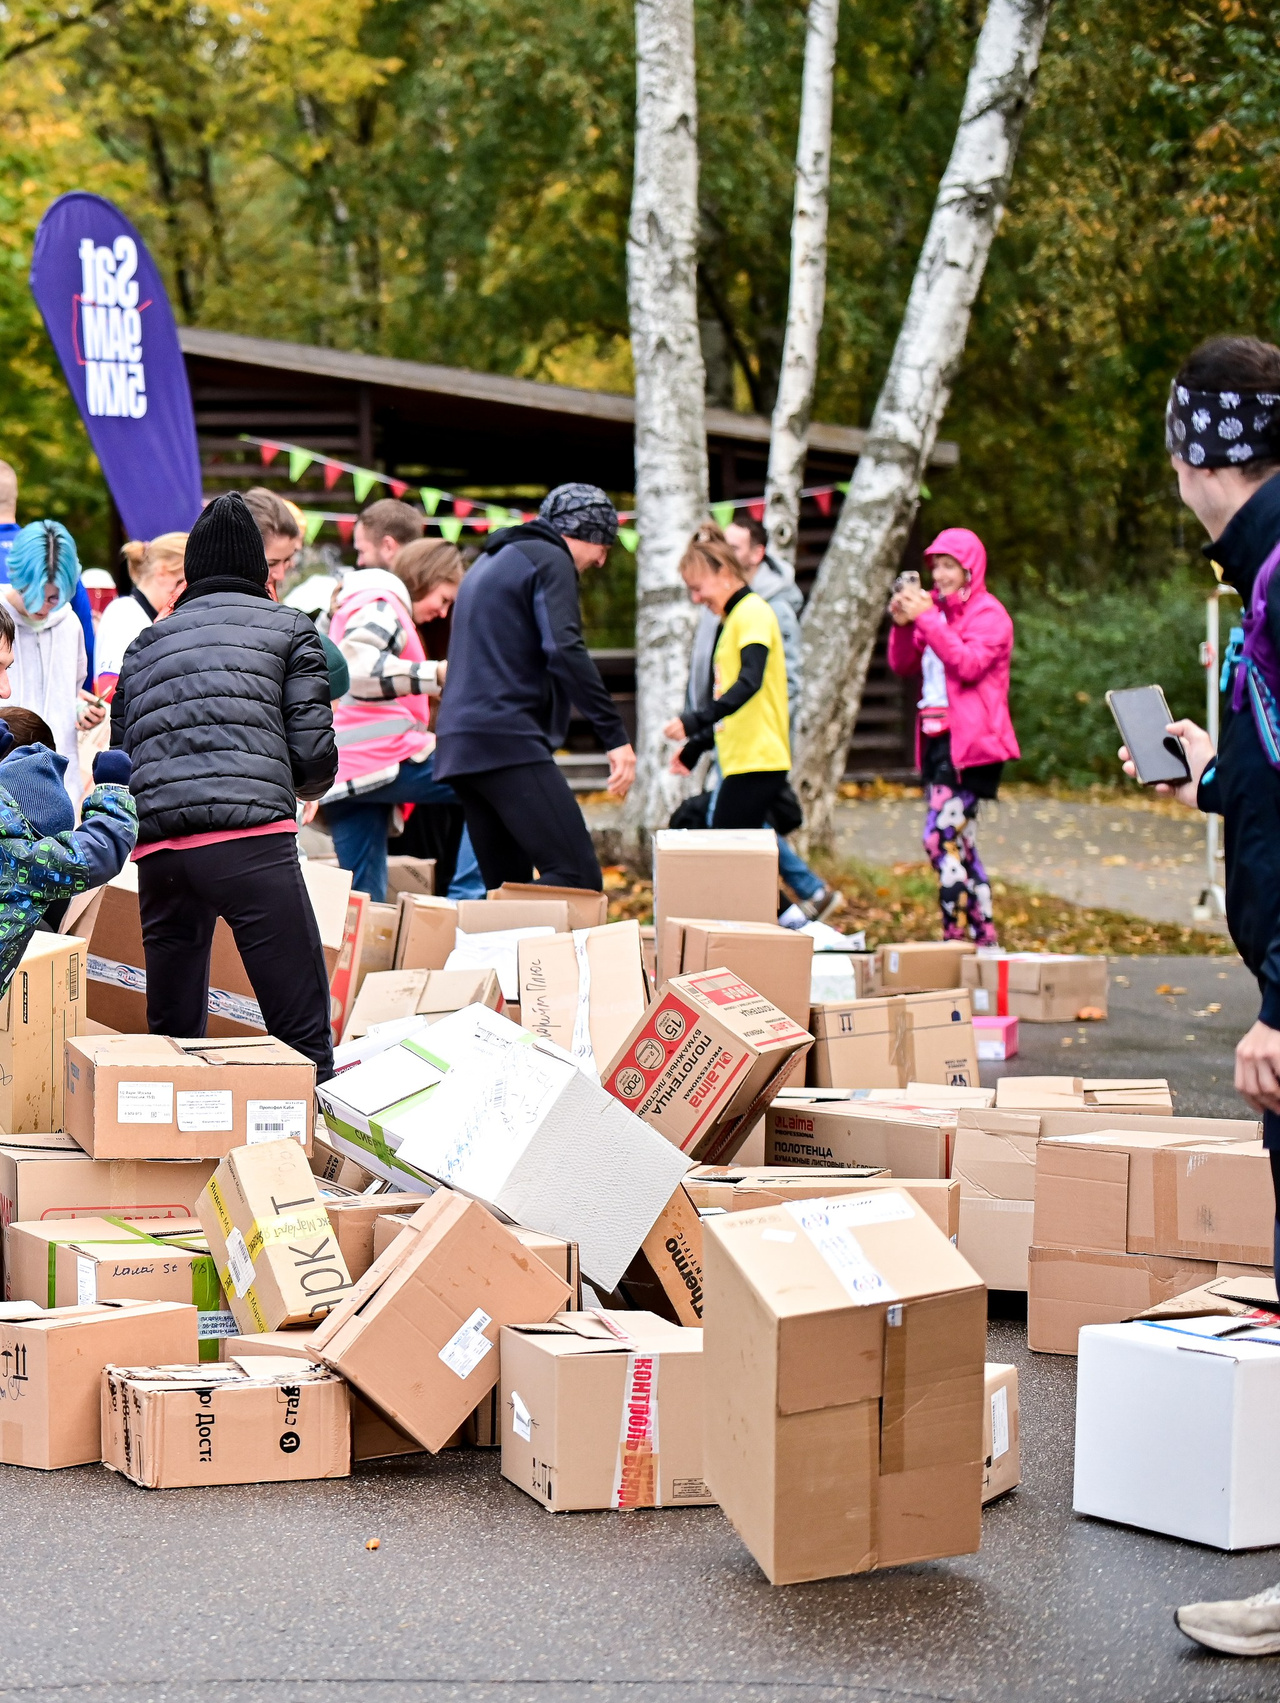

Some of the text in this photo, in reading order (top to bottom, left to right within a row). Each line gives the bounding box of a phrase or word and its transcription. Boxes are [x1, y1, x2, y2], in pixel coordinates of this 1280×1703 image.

[526, 958, 548, 991] Плюс
[664, 1019, 682, 1038] 15
[665, 1028, 702, 1079] БУМАЖНЫЕ
[624, 1074, 642, 1096] 200
[651, 1034, 713, 1116] ПОЛОТЕНЦА
[683, 1046, 723, 1101] PROFESSIONAL
[688, 1060, 726, 1110] Laima
[774, 1129, 814, 1139] PROFESSIONAL
[782, 1115, 814, 1132] Laima
[774, 1141, 833, 1158] ПОЛОТЕНЦА
[774, 1155, 810, 1166] БУМАЖНЫЕ
[811, 1159, 845, 1169] ЛИСТОВЫЕ
[210, 1181, 226, 1218] Яндекс
[666, 1237, 704, 1319] Thermo
